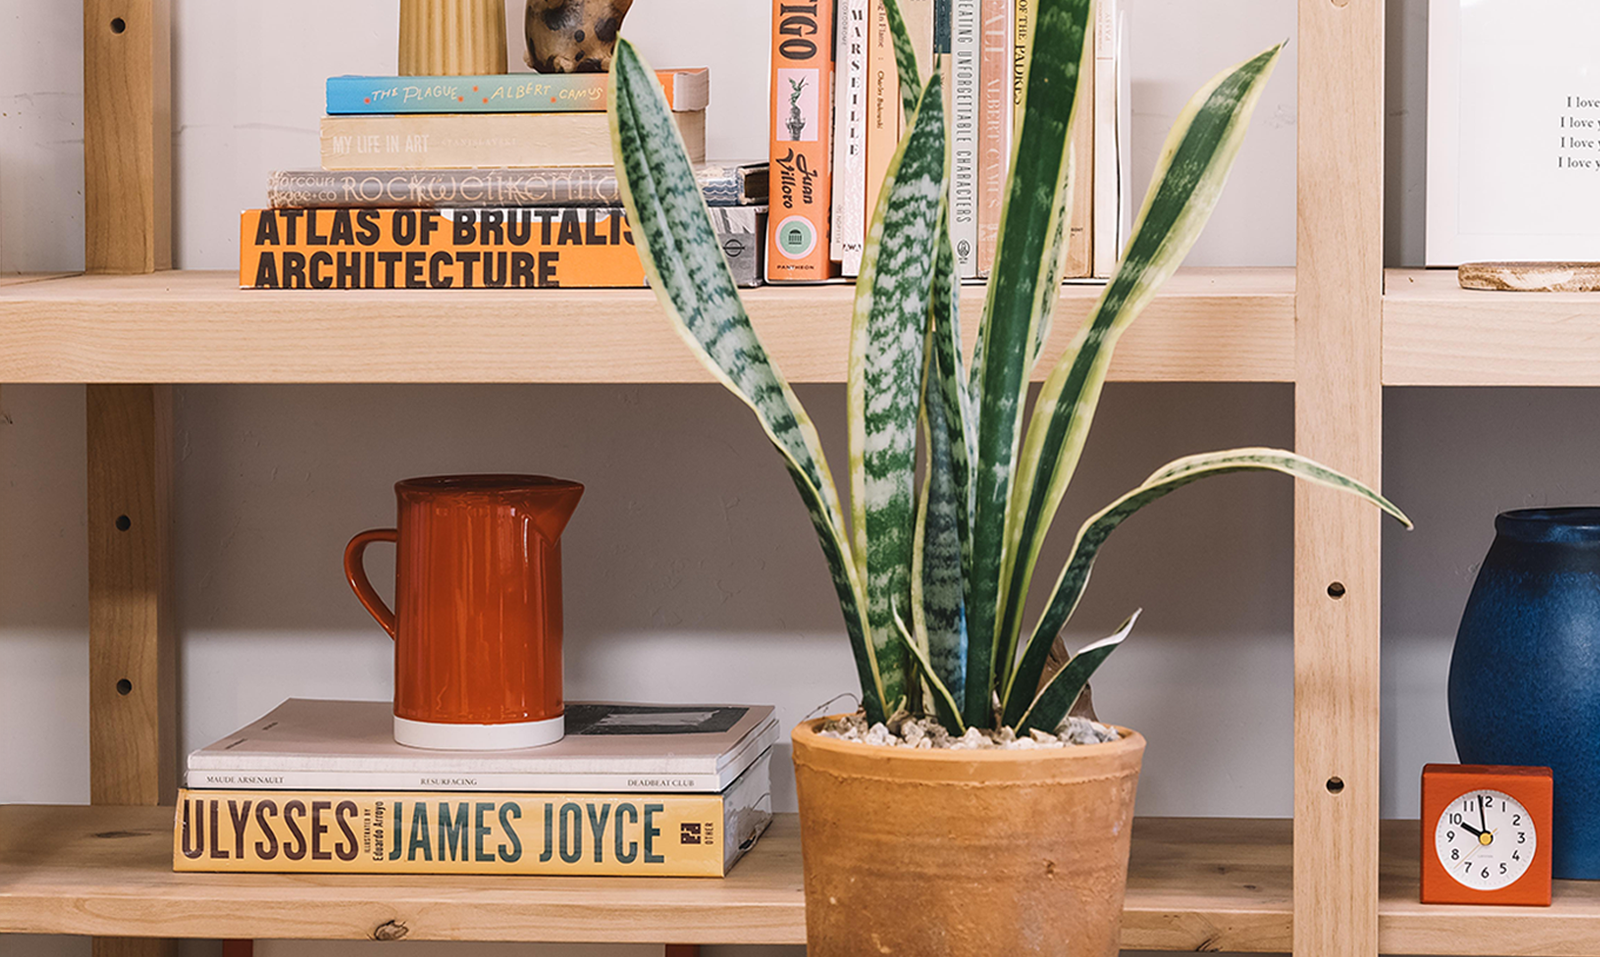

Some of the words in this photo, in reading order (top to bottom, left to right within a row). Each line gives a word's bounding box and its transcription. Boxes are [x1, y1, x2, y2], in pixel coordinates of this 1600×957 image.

[1018, 15, 1028, 40] THE
[371, 87, 398, 102] THE
[402, 85, 458, 103] PLAGUE
[490, 83, 551, 100] ALBERT
[558, 86, 604, 101] CAMUS
[956, 50, 973, 142] UNFORGETTABLE
[1566, 96, 1572, 108] I
[1576, 96, 1600, 108] love
[986, 78, 1000, 143] ALBERT
[1560, 116, 1565, 128] I
[1569, 116, 1594, 128] love
[332, 135, 353, 154] MY
[357, 135, 381, 154] LIFE
[386, 135, 400, 153] IN
[405, 134, 430, 153] ART
[1560, 136, 1565, 148] I
[1569, 136, 1594, 148] love
[1557, 156, 1563, 168] I
[1567, 156, 1592, 168] love
[775, 147, 796, 210] Villoro
[796, 153, 818, 205] Juan
[985, 148, 1000, 209] CAMUS
[955, 150, 972, 223] CHARACTERS
[254, 209, 381, 247] ATLAS
[391, 209, 441, 247] OF
[254, 250, 561, 289] ARCHITECTURE
[206, 776, 236, 784] MAUDE
[237, 776, 284, 784] ARSENAULT
[420, 777, 478, 786] RESURFACING
[627, 778, 670, 787] DEADBEAT
[671, 778, 695, 787] CLUB
[1463, 800, 1474, 812] 11
[372, 801, 386, 828] Arroyo
[1449, 813, 1462, 825] 10
[1512, 814, 1521, 826] 2
[181, 797, 361, 862] ULYSSES
[388, 800, 523, 865] JAMES
[537, 801, 665, 865] JOYCE
[1446, 830, 1455, 843] 9
[1517, 832, 1525, 844] 3
[372, 829, 384, 862] Eduardo
[1451, 848, 1459, 860] 8
[1512, 850, 1520, 861] 4
[1464, 862, 1472, 873] 7
[1481, 867, 1490, 879] 6
[1499, 862, 1507, 874] 5
